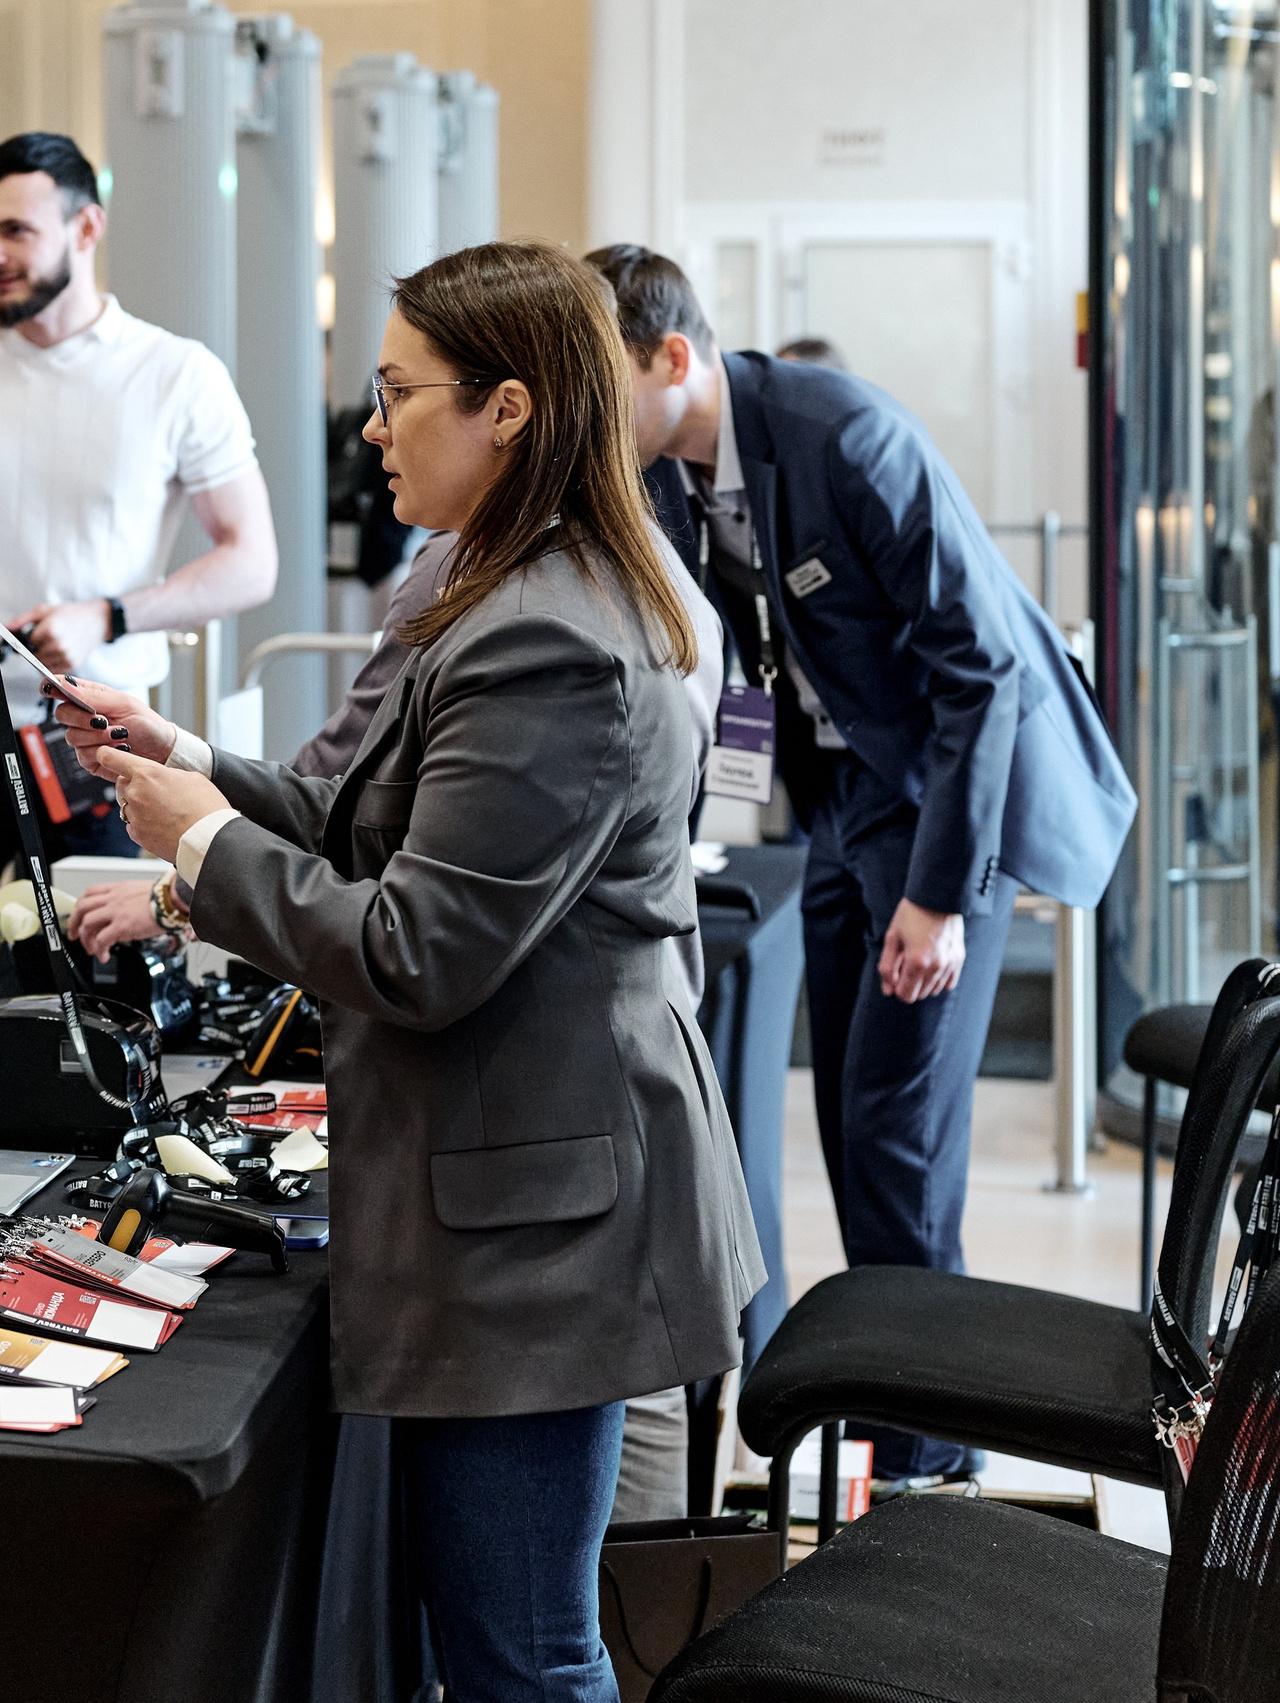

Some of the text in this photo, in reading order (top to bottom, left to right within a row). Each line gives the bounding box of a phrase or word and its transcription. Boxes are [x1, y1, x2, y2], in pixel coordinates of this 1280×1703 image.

[11, 780, 29, 816] BATYREV
[90, 1199, 112, 1208] BATYR
[1246, 1202, 1259, 1235] BATYREV
[42, 1292, 64, 1320] КОМАНДА
[1156, 1294, 1175, 1326] BATYREV
[1224, 1290, 1237, 1322] BATYREV
[36, 1320, 80, 1334] BATYREV
